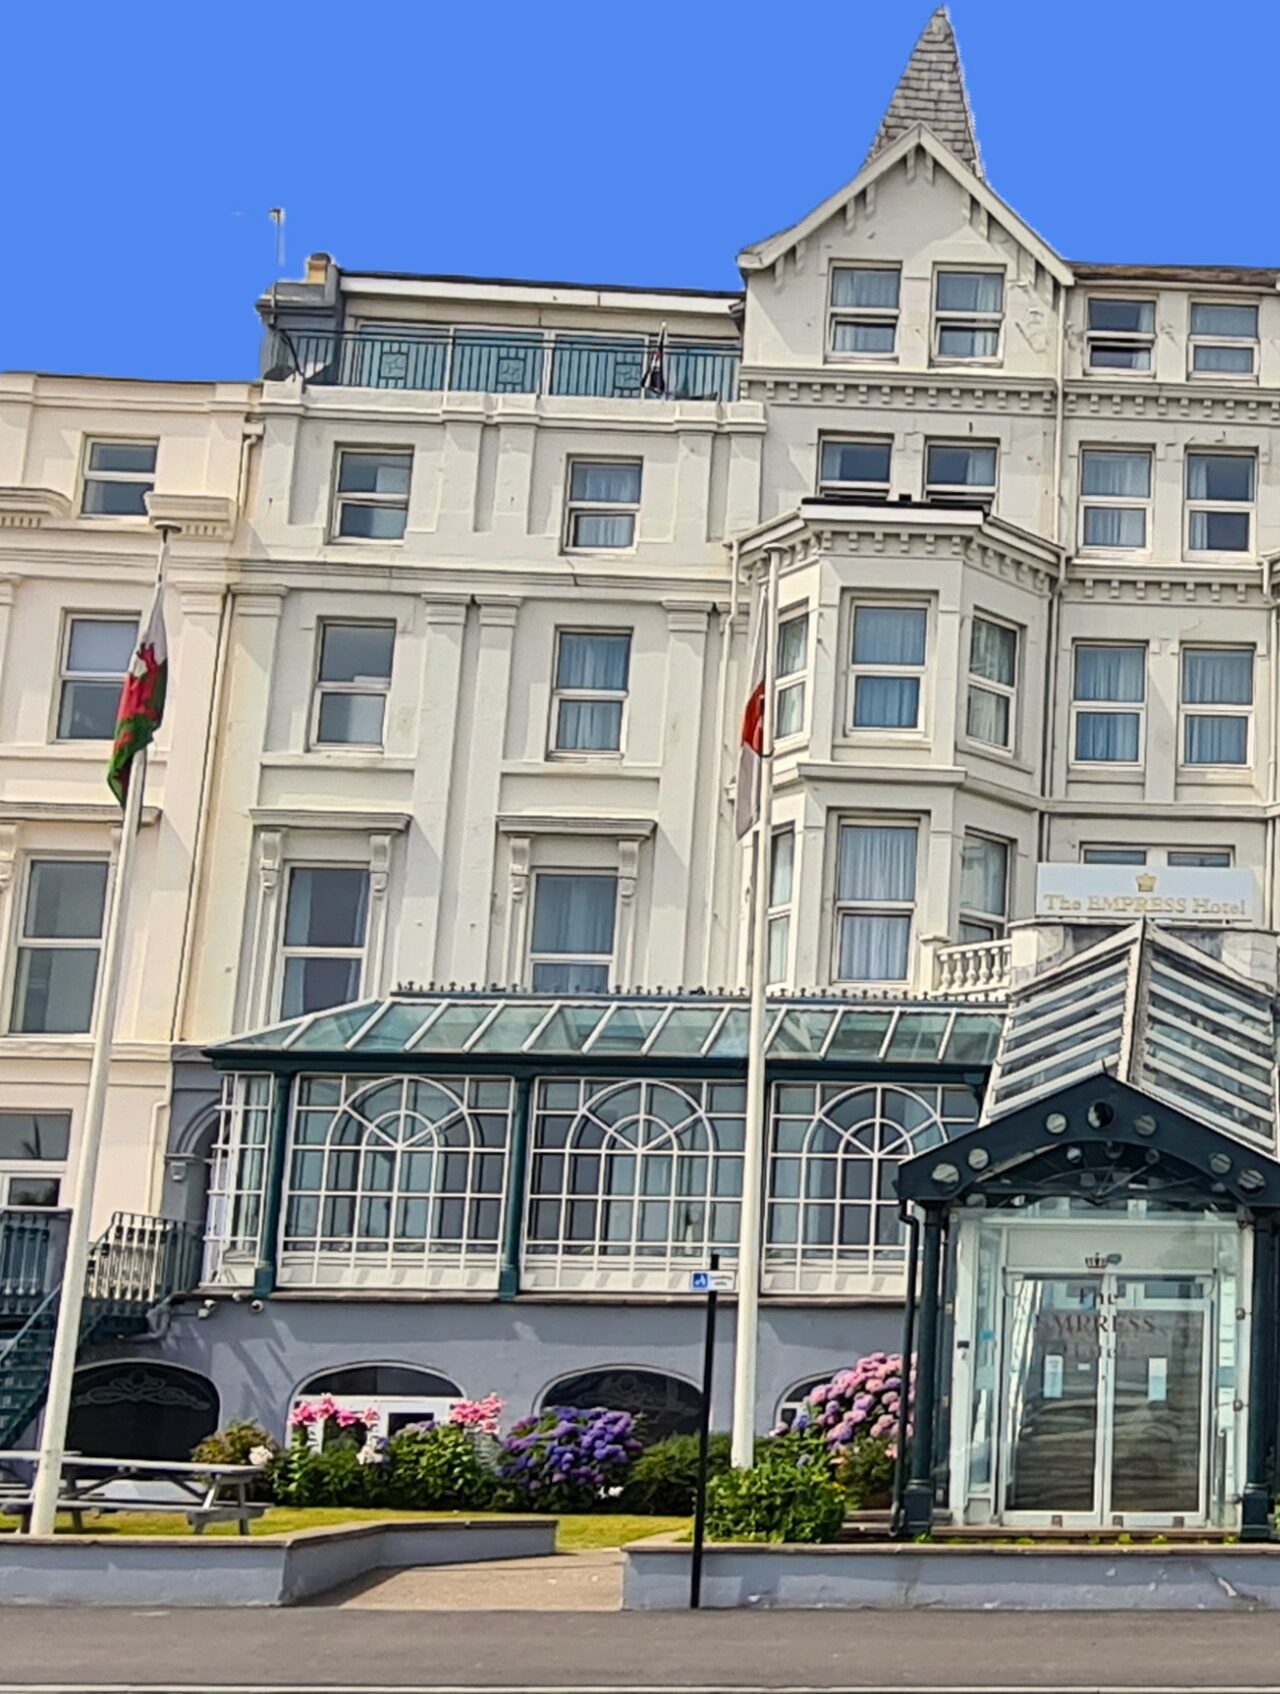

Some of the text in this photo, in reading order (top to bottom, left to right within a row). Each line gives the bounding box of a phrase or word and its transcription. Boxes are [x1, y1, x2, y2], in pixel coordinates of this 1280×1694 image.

[1043, 893, 1247, 915] The EMPRESS Hotel
